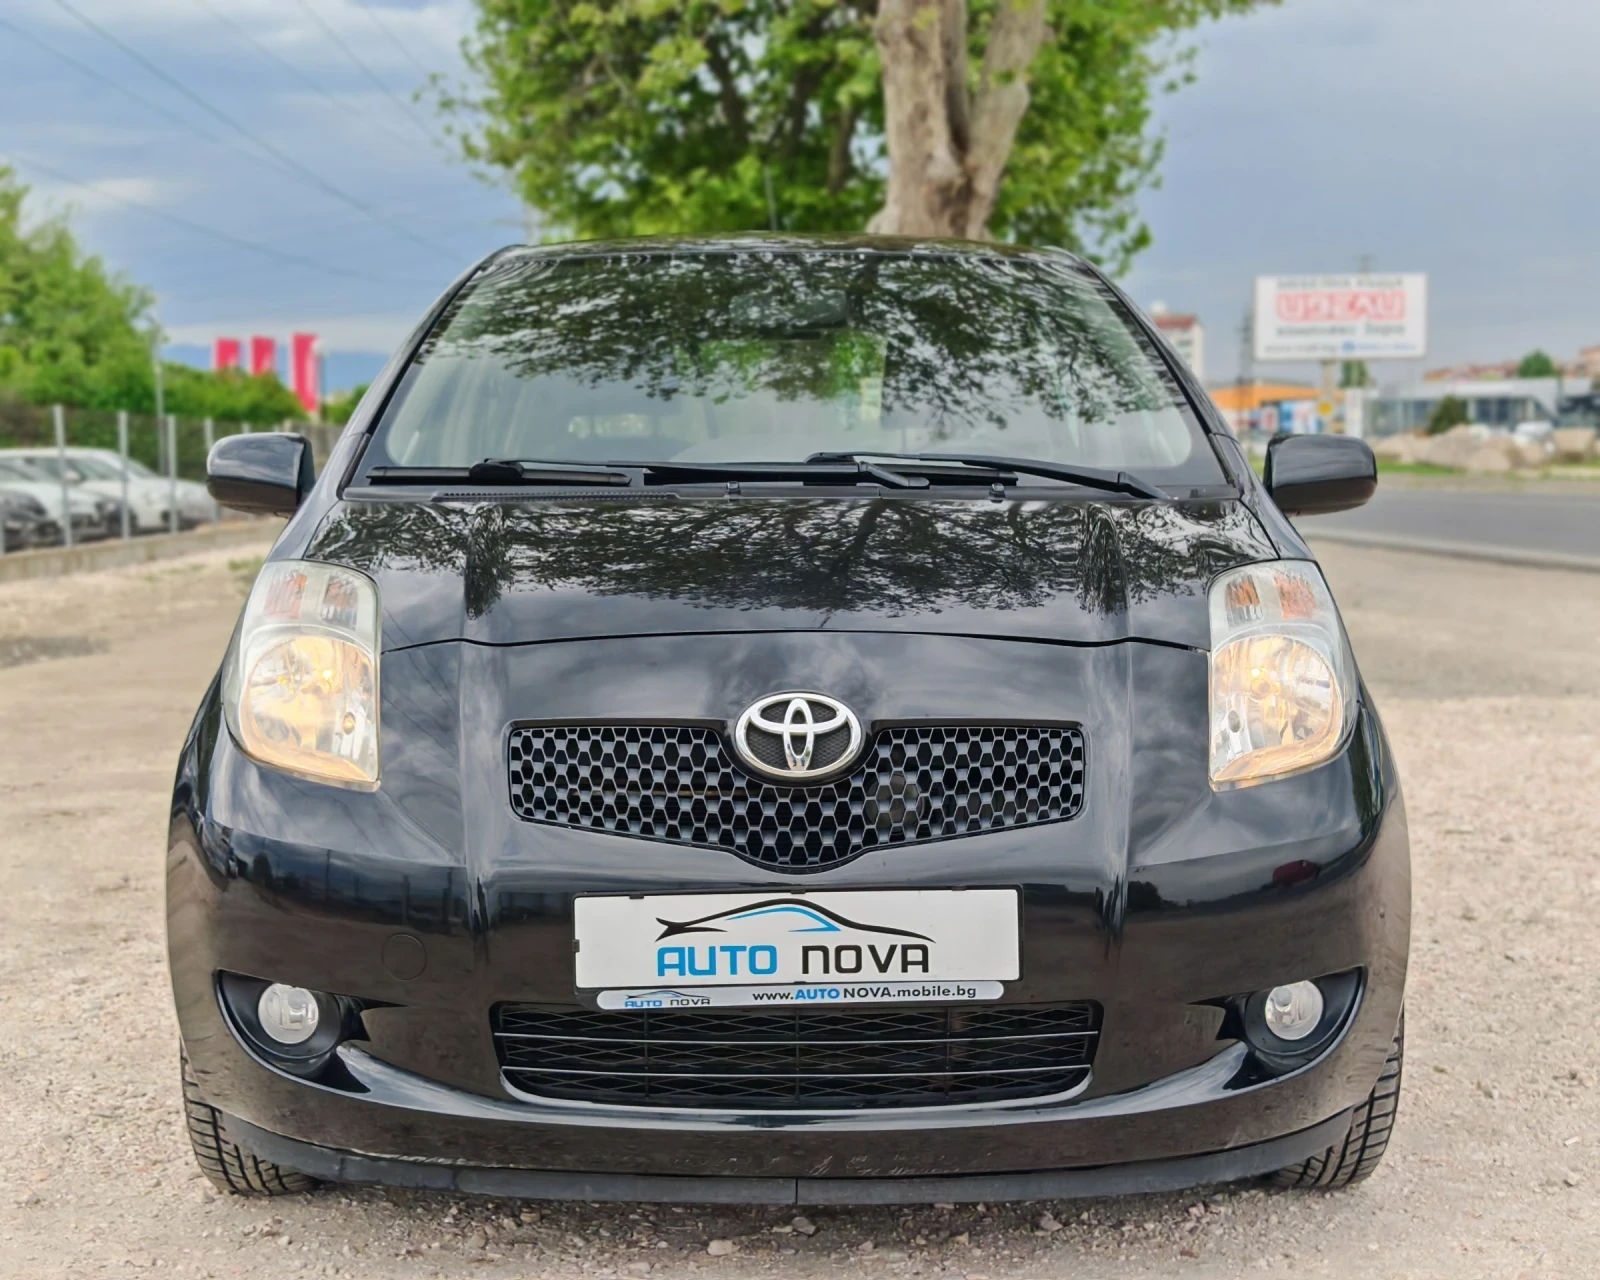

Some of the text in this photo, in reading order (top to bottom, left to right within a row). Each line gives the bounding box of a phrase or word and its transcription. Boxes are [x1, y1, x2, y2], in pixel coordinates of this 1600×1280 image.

[657, 943, 930, 977] AUTO NOVA
[624, 999, 663, 1008] AUTO
